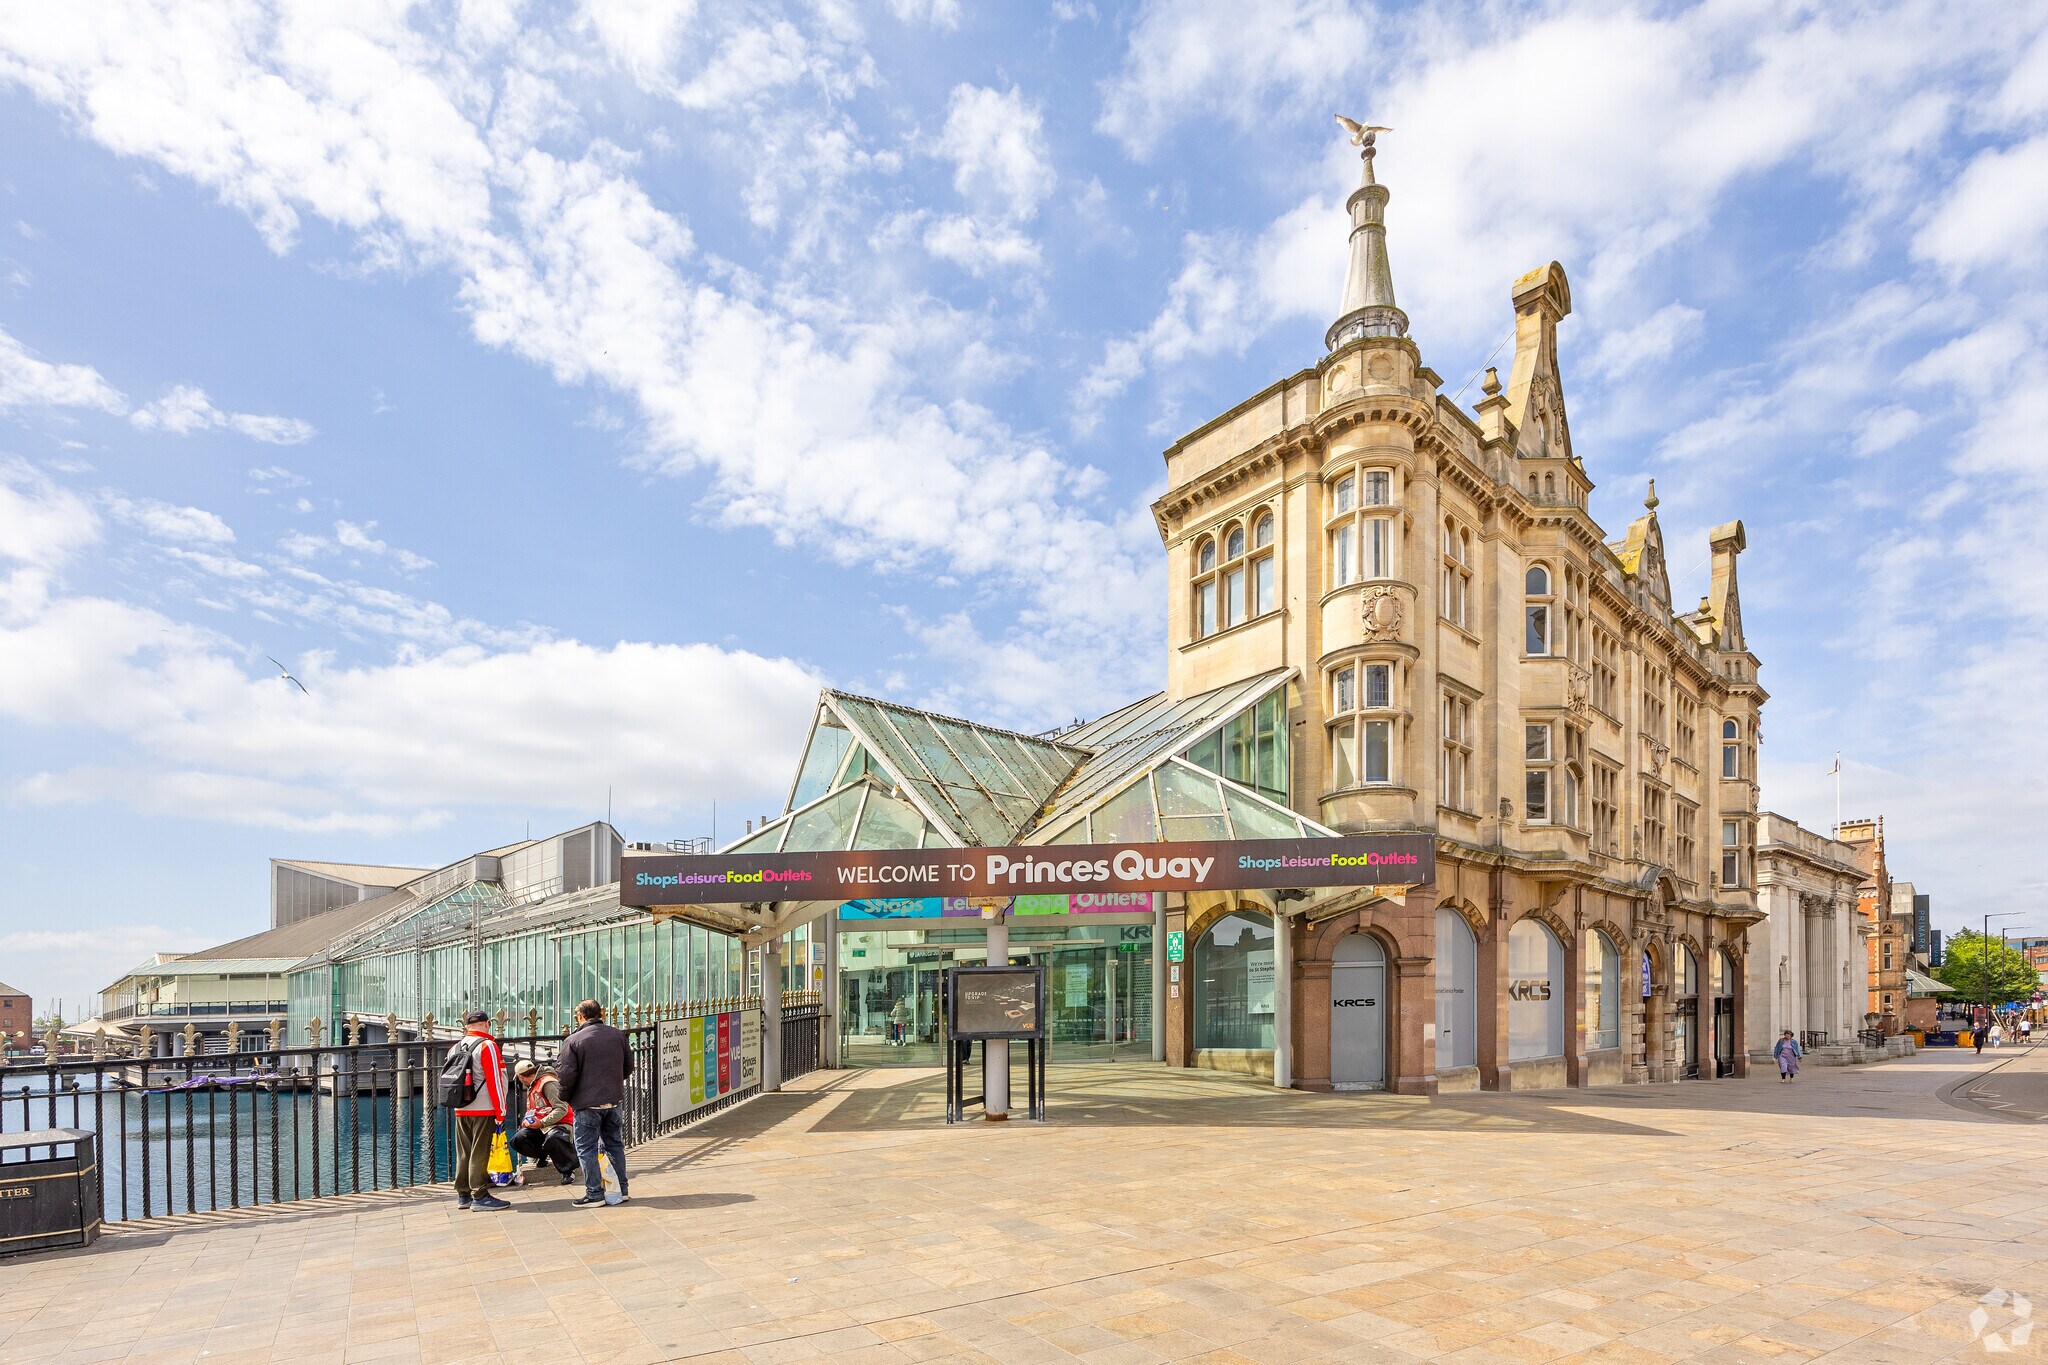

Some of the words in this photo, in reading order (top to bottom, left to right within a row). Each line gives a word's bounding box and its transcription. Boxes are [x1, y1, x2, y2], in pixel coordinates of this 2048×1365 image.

[837, 864, 940, 884] WELCOME
[947, 864, 976, 882] TO
[864, 898, 924, 916] Shops
[1076, 892, 1147, 908] Outlets
[1509, 980, 1551, 1001] KRCS
[1334, 998, 1376, 1007] KRCS
[663, 1028, 674, 1039] Four
[674, 1025, 687, 1037] floors
[663, 1042, 668, 1054] of
[668, 1070, 684, 1084] fashion
